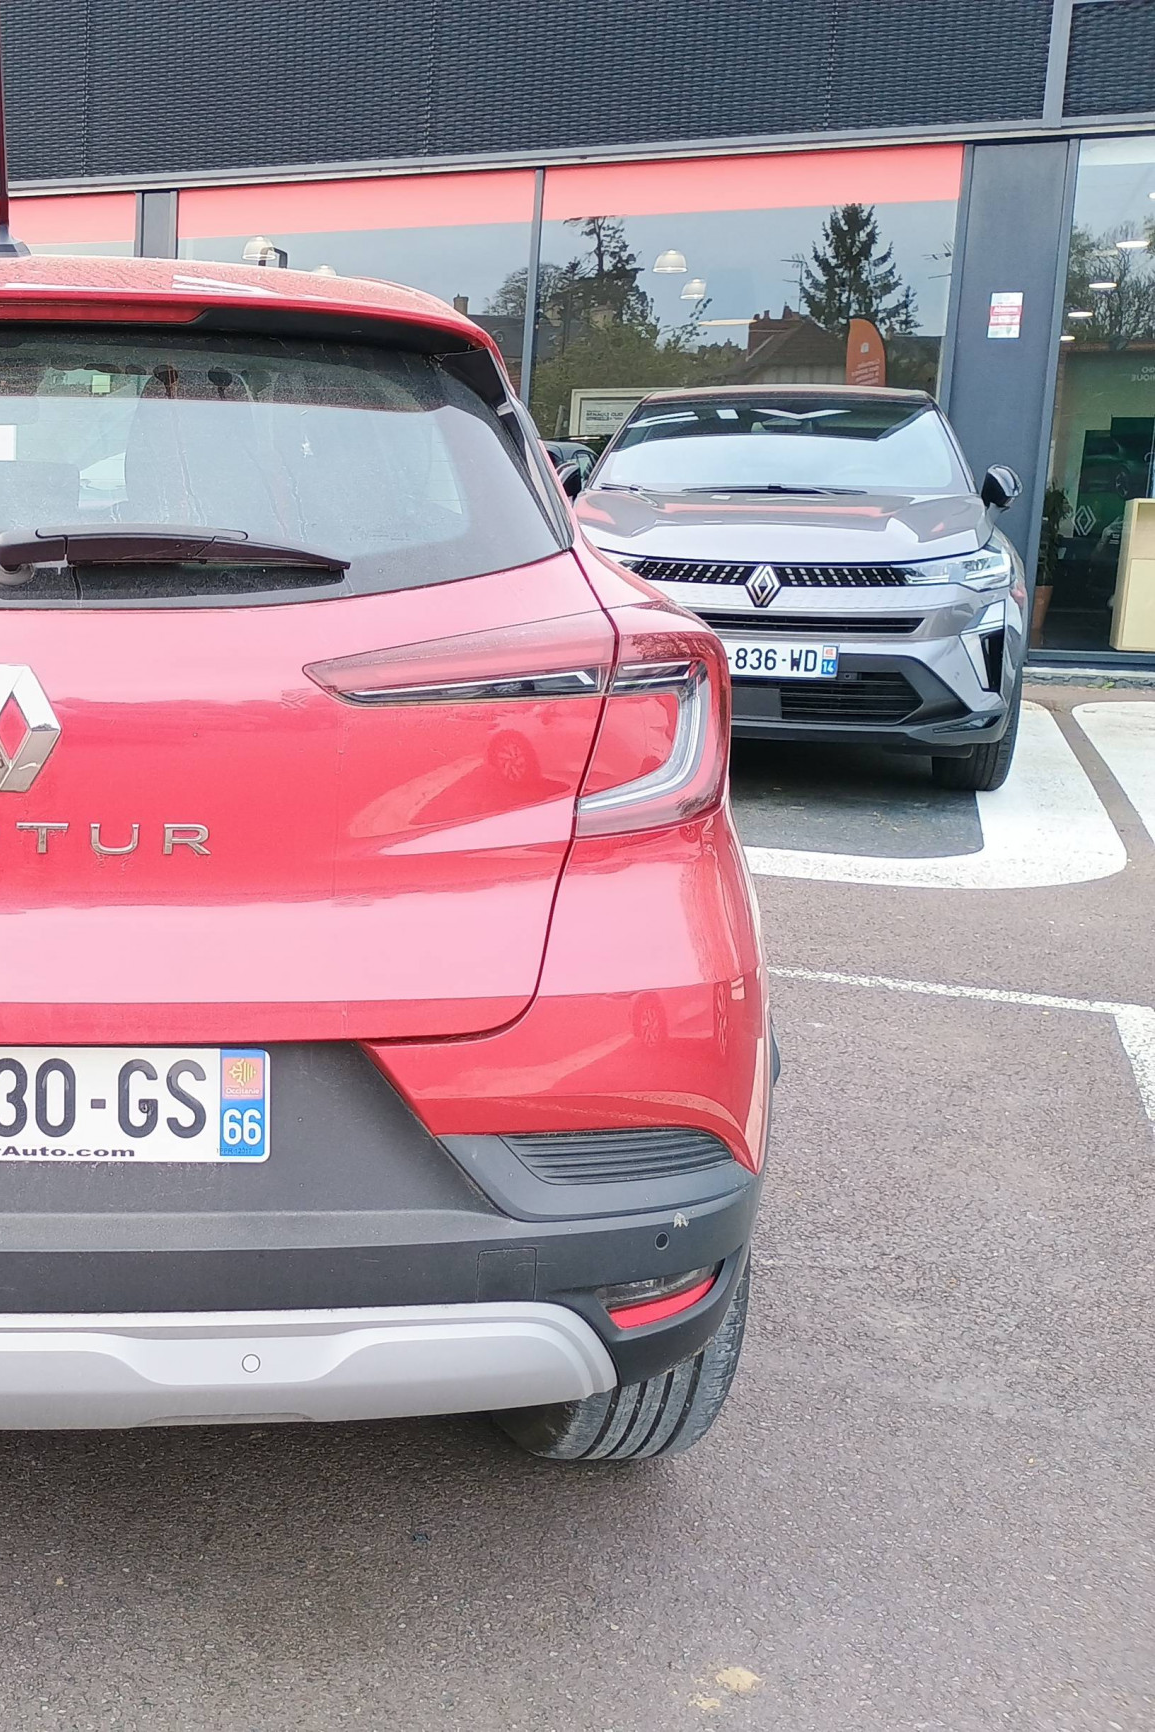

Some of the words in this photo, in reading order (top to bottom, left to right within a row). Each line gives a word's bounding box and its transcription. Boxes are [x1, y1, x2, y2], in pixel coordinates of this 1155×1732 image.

[822, 661, 835, 674] 14
[225, 1087, 261, 1095] Occitanie
[222, 1109, 262, 1146] 66
